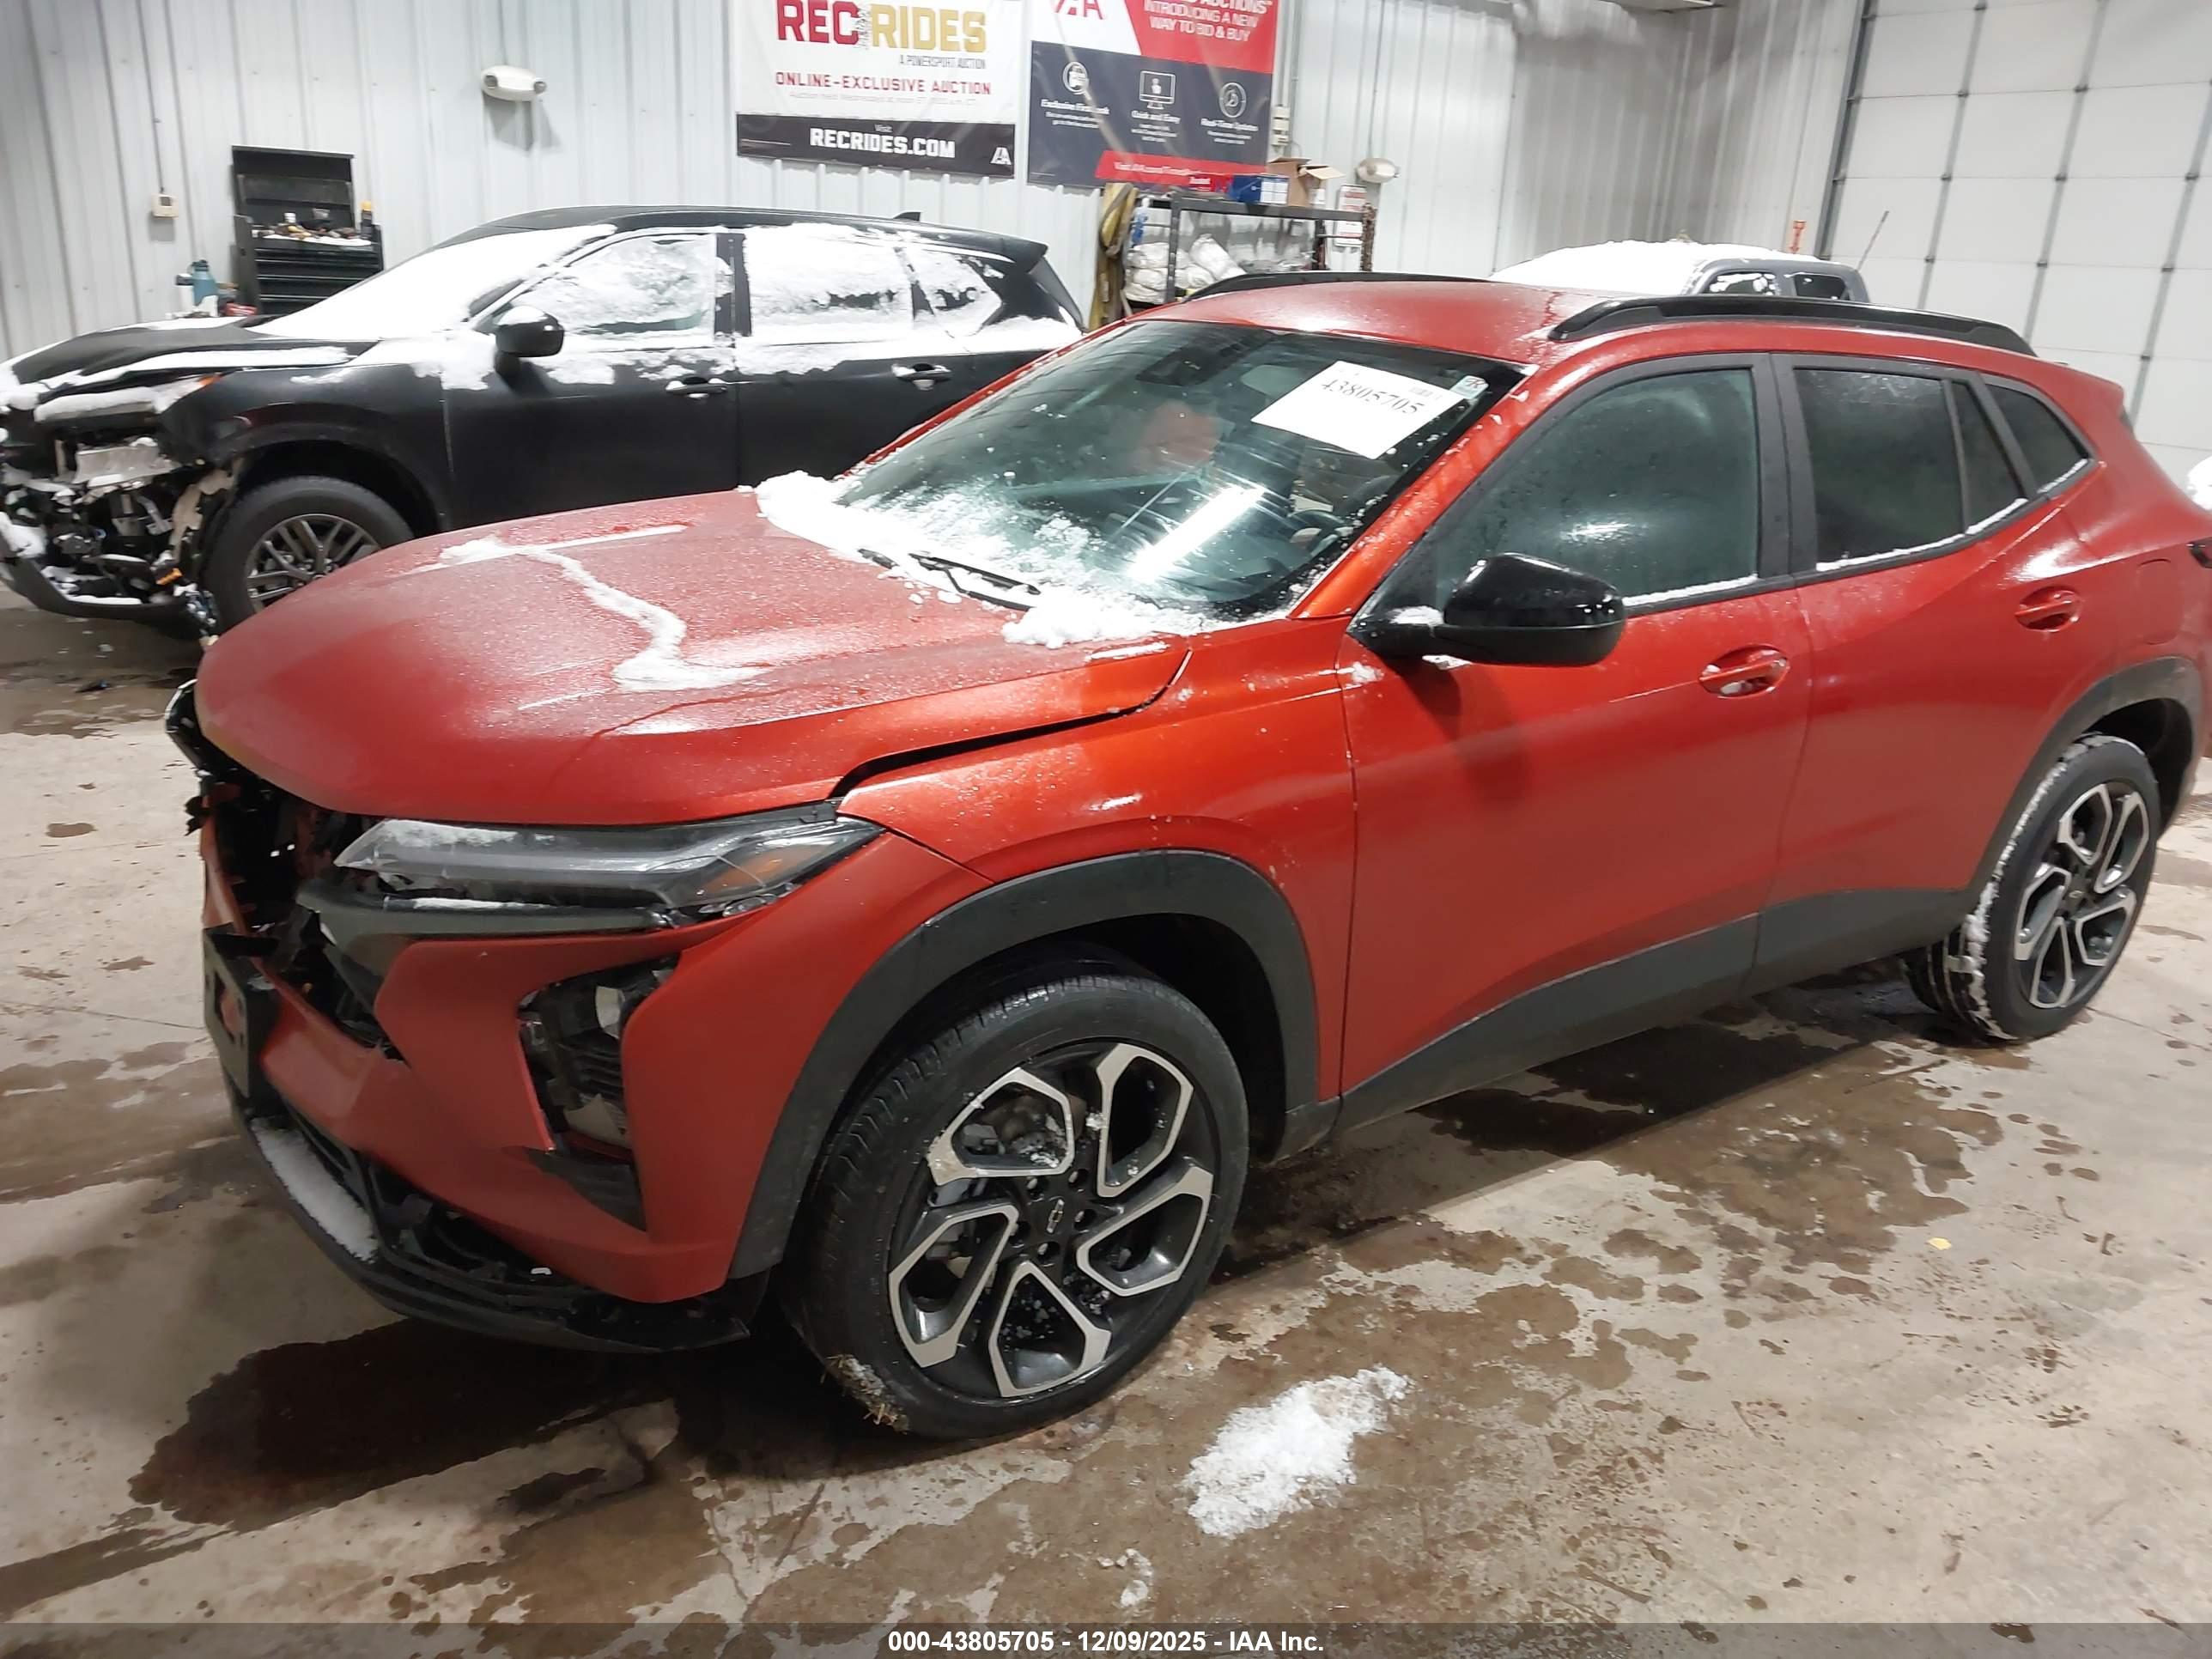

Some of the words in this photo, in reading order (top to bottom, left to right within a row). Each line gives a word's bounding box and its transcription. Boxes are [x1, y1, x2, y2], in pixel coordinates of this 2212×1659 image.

[776, 0, 860, 45] REC
[871, 3, 987, 52] RIDES
[1149, 15, 1177, 31] WAY
[1177, 20, 1195, 34] TO
[1215, 25, 1225, 39] &
[1226, 27, 1251, 42] BUY
[1221, 11, 1231, 24] A
[1231, 13, 1259, 28] NEW
[776, 71, 926, 93] ONLINE-EXCLUSIVE
[931, 81, 991, 95] AUCTION
[810, 127, 956, 159] RECRIDES.COM
[1322, 379, 1425, 414] 43805705
